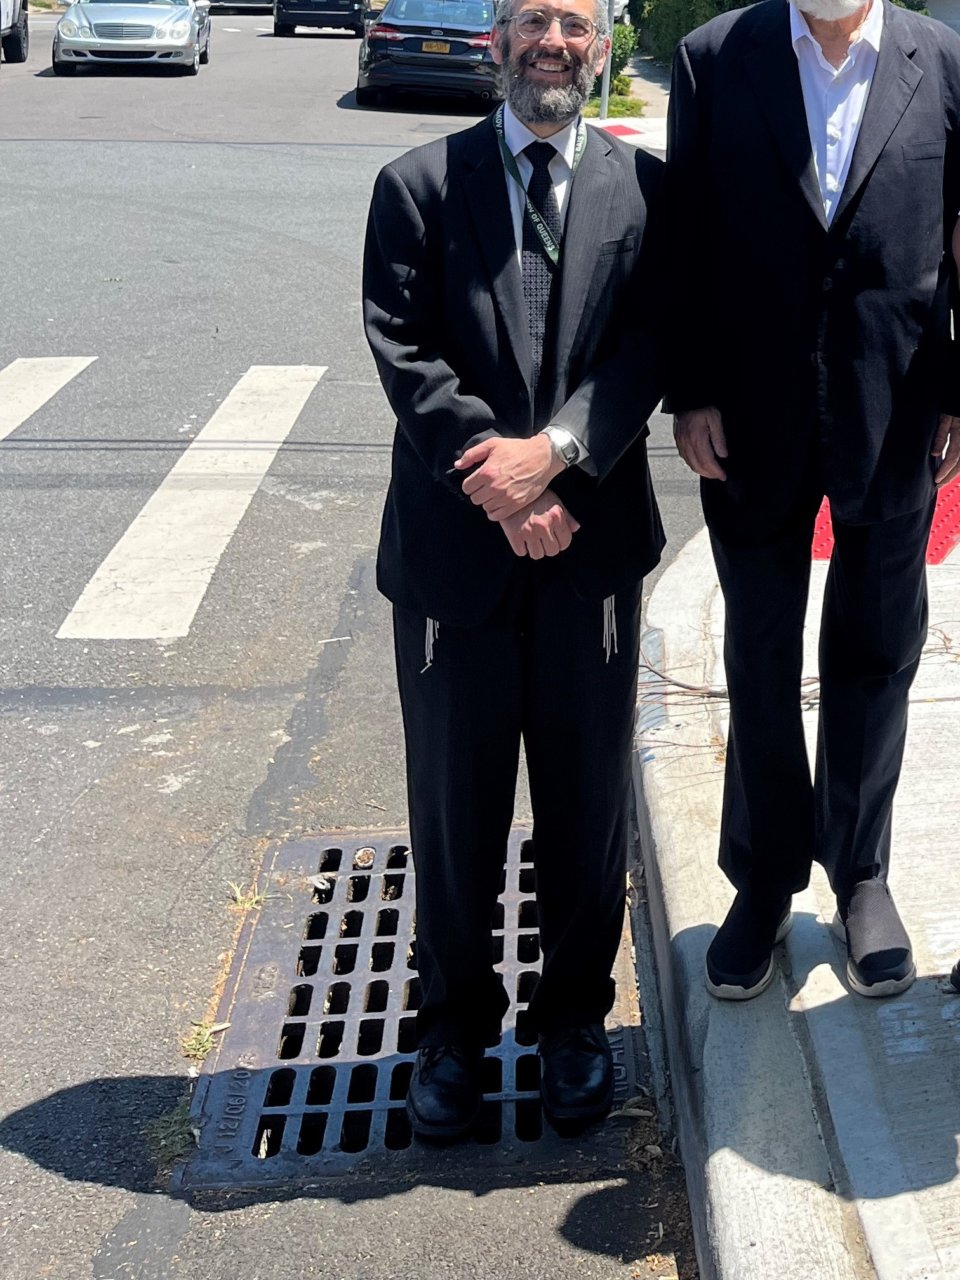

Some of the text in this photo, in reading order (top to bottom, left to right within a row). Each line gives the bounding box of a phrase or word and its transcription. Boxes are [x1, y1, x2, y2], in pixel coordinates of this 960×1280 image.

[575, 136, 584, 151] BAIS
[531, 213, 540, 223] OF
[536, 223, 556, 252] QUEENS
